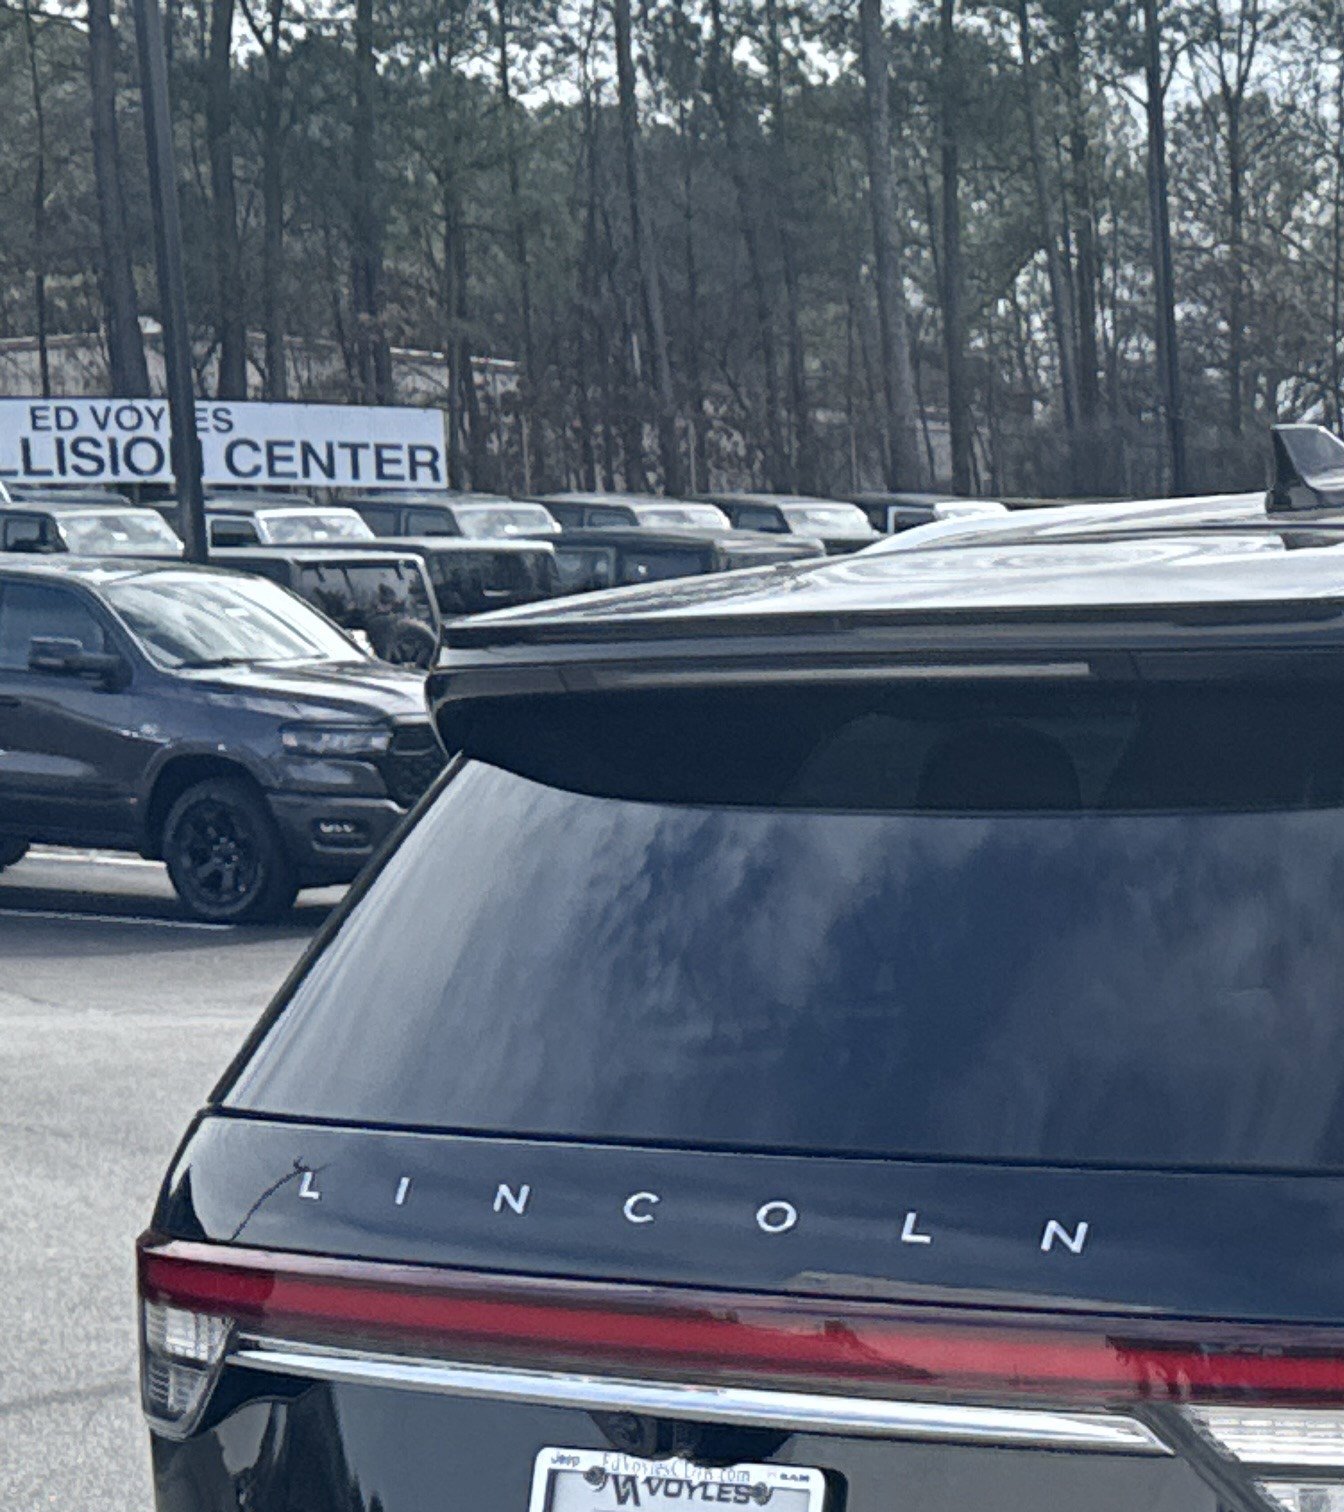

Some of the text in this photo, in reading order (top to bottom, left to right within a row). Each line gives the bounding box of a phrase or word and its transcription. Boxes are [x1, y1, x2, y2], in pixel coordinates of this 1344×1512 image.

[30, 405, 234, 434] ED VOYES
[0, 436, 441, 483] LISIO CENTER
[299, 1171, 1088, 1254] LINCOLN
